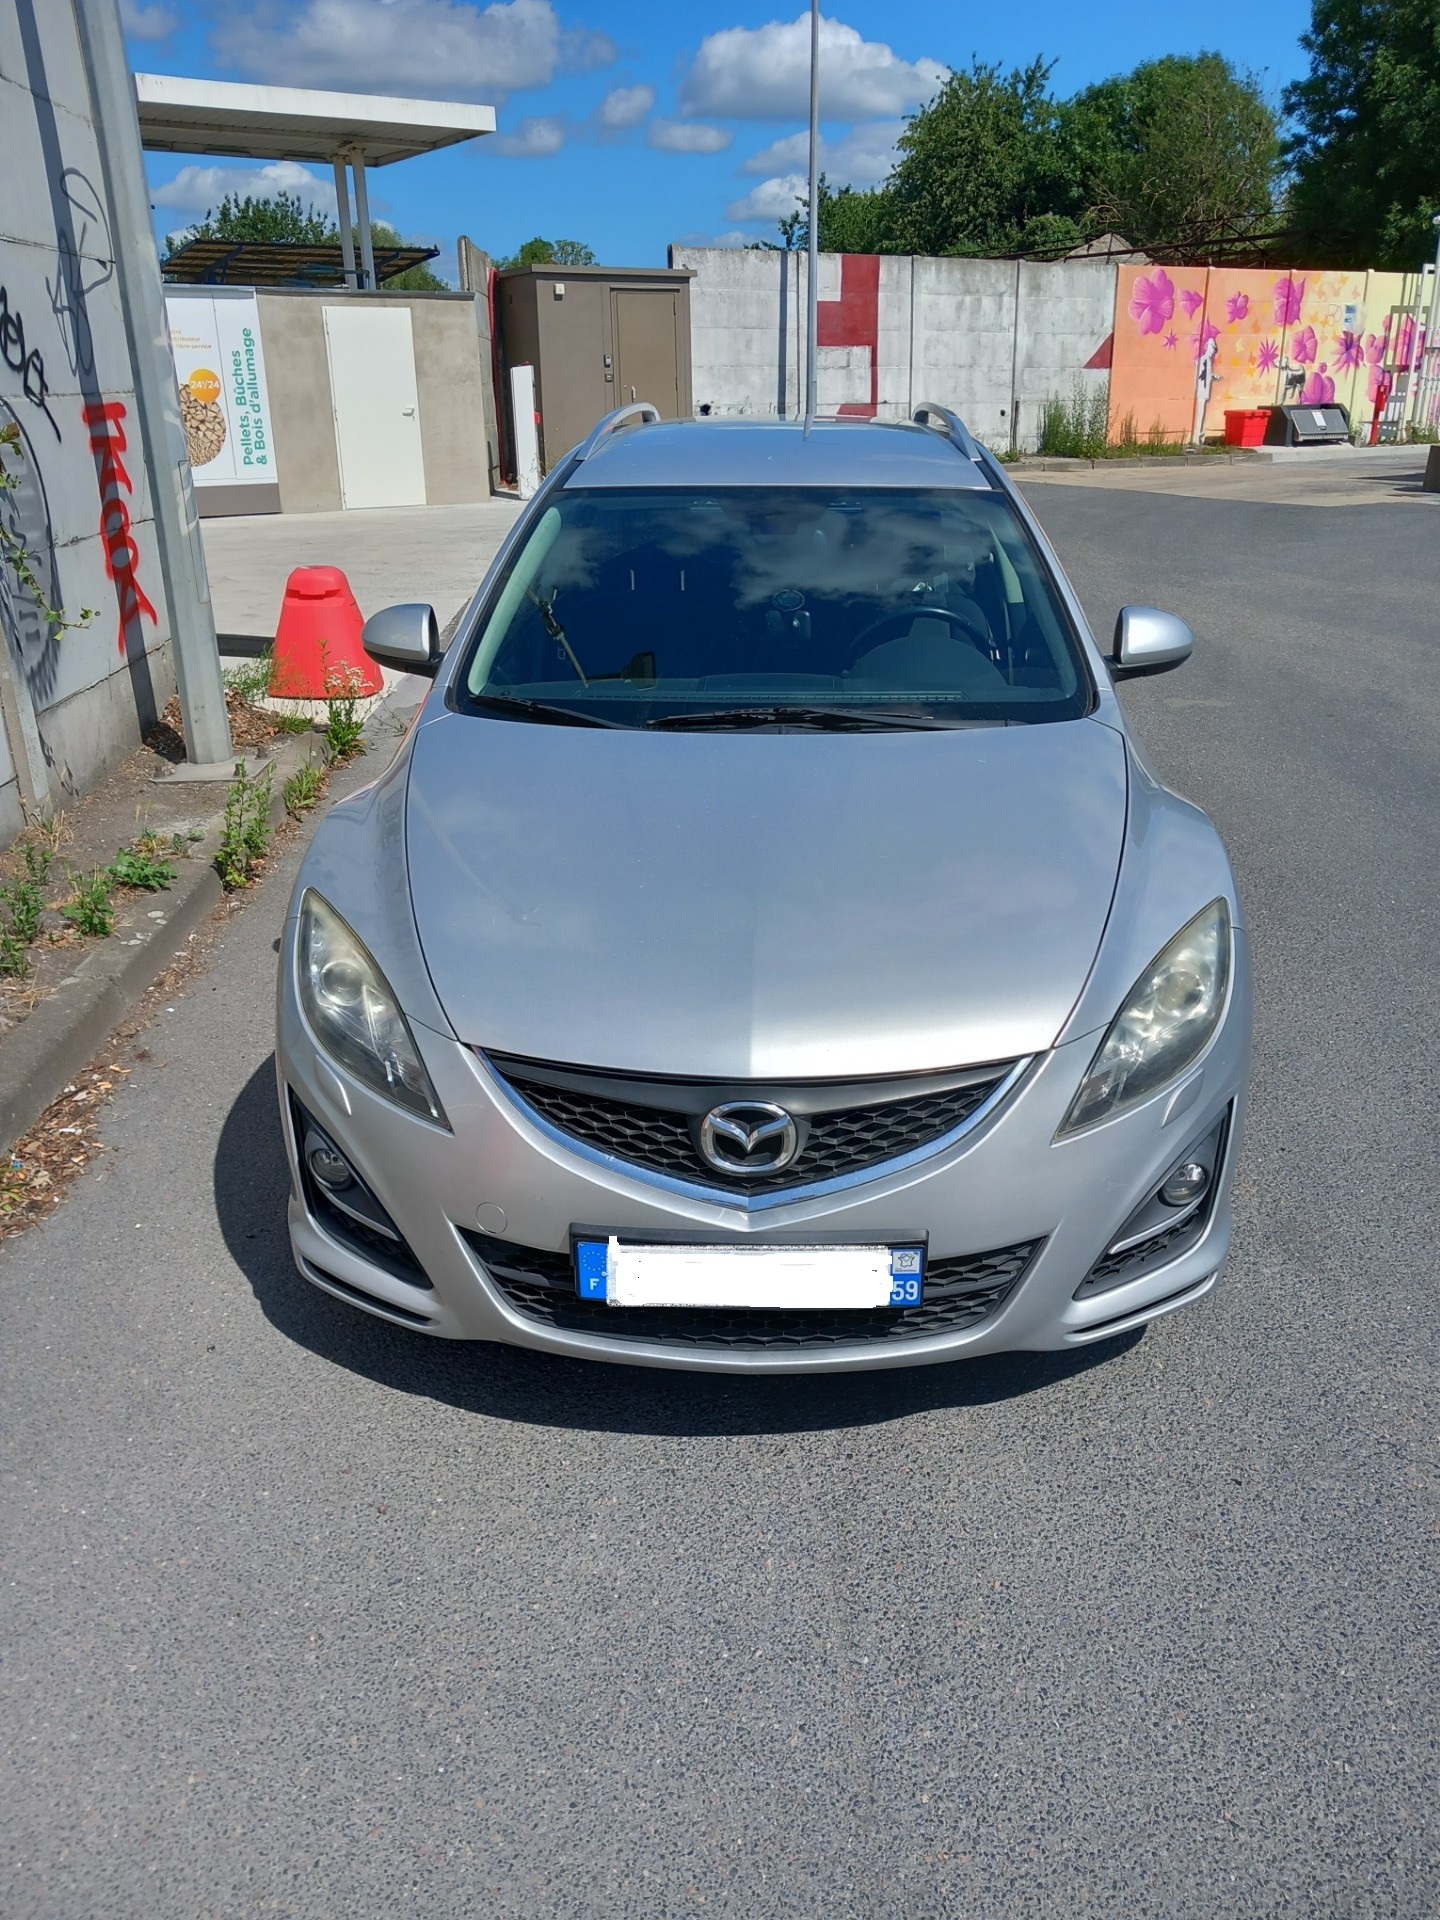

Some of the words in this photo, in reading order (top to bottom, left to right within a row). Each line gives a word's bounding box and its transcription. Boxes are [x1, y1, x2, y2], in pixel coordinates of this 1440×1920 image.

[232, 350, 247, 406] Bûches
[243, 328, 261, 413] d'allumage
[239, 411, 254, 465] Pellets,
[252, 418, 265, 450] Bois
[256, 455, 267, 465] &
[590, 1278, 600, 1291] F
[892, 1281, 919, 1301] 59
